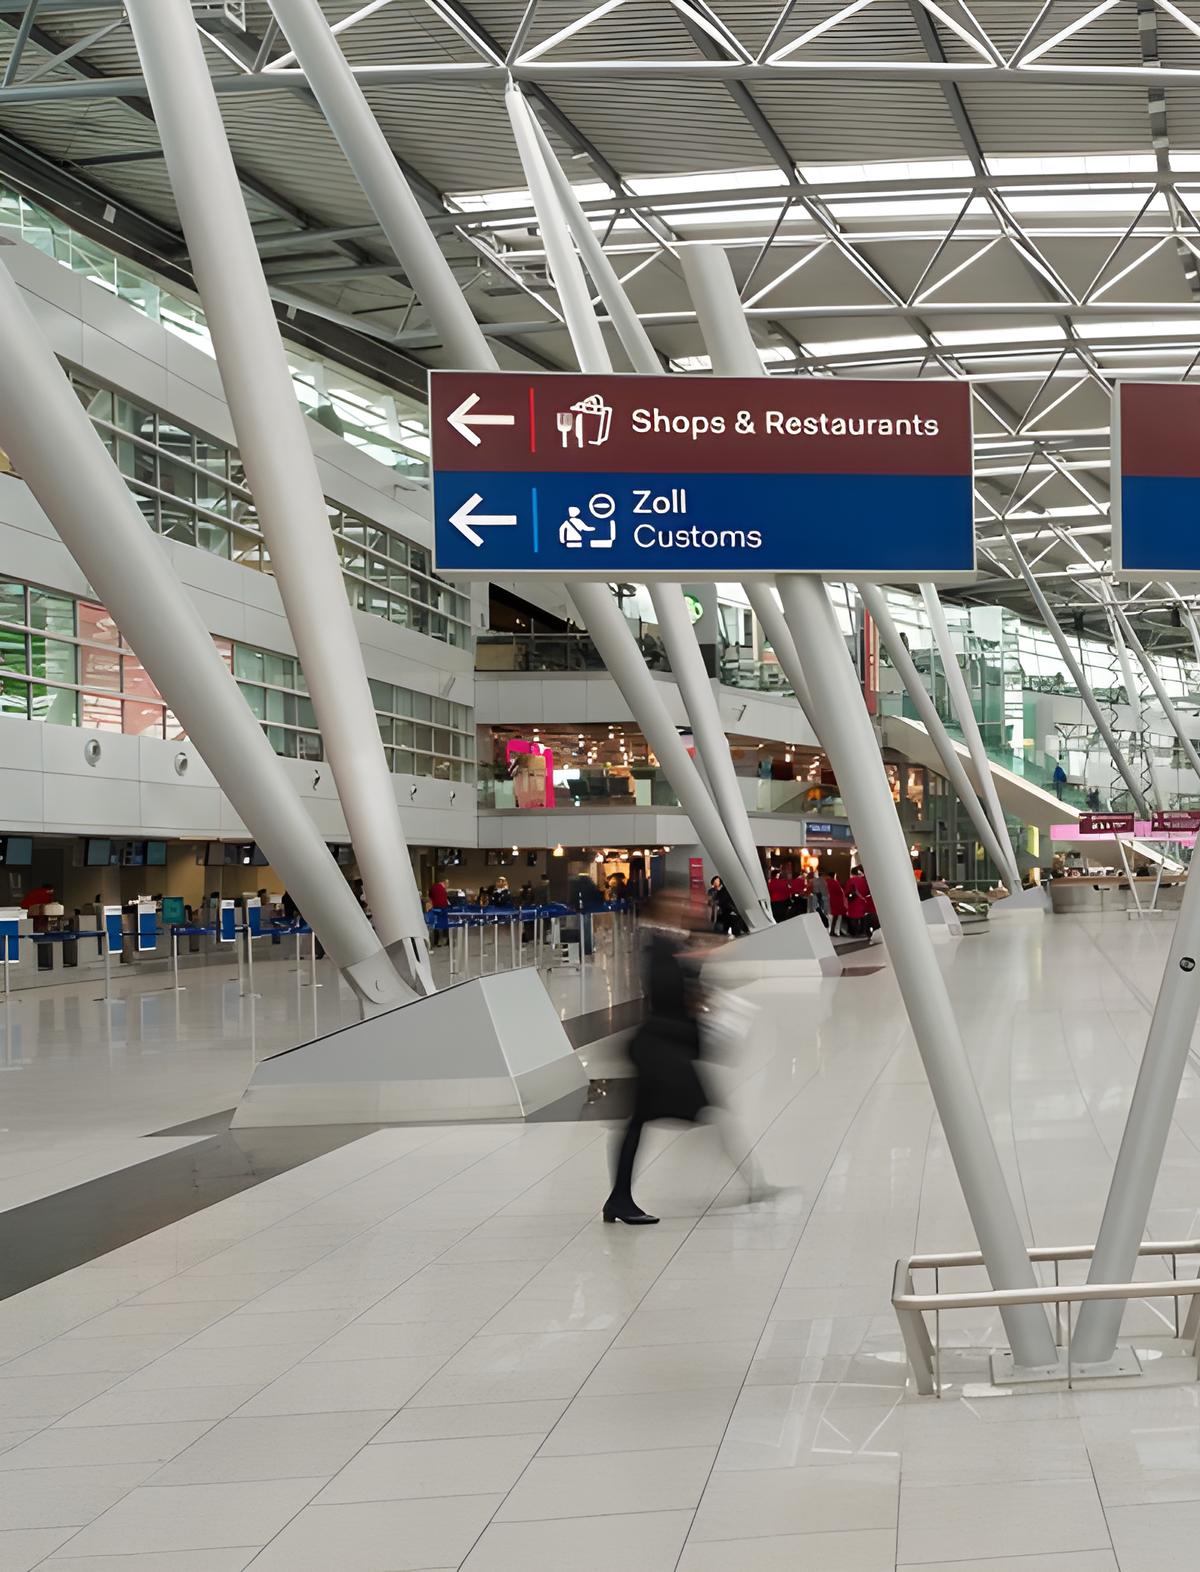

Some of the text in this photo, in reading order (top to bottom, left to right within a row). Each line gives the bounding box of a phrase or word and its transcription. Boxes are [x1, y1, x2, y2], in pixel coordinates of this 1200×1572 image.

[633, 407, 939, 440] Shops & Restaurants
[632, 488, 687, 514] Zoll
[633, 523, 762, 549] Customs
